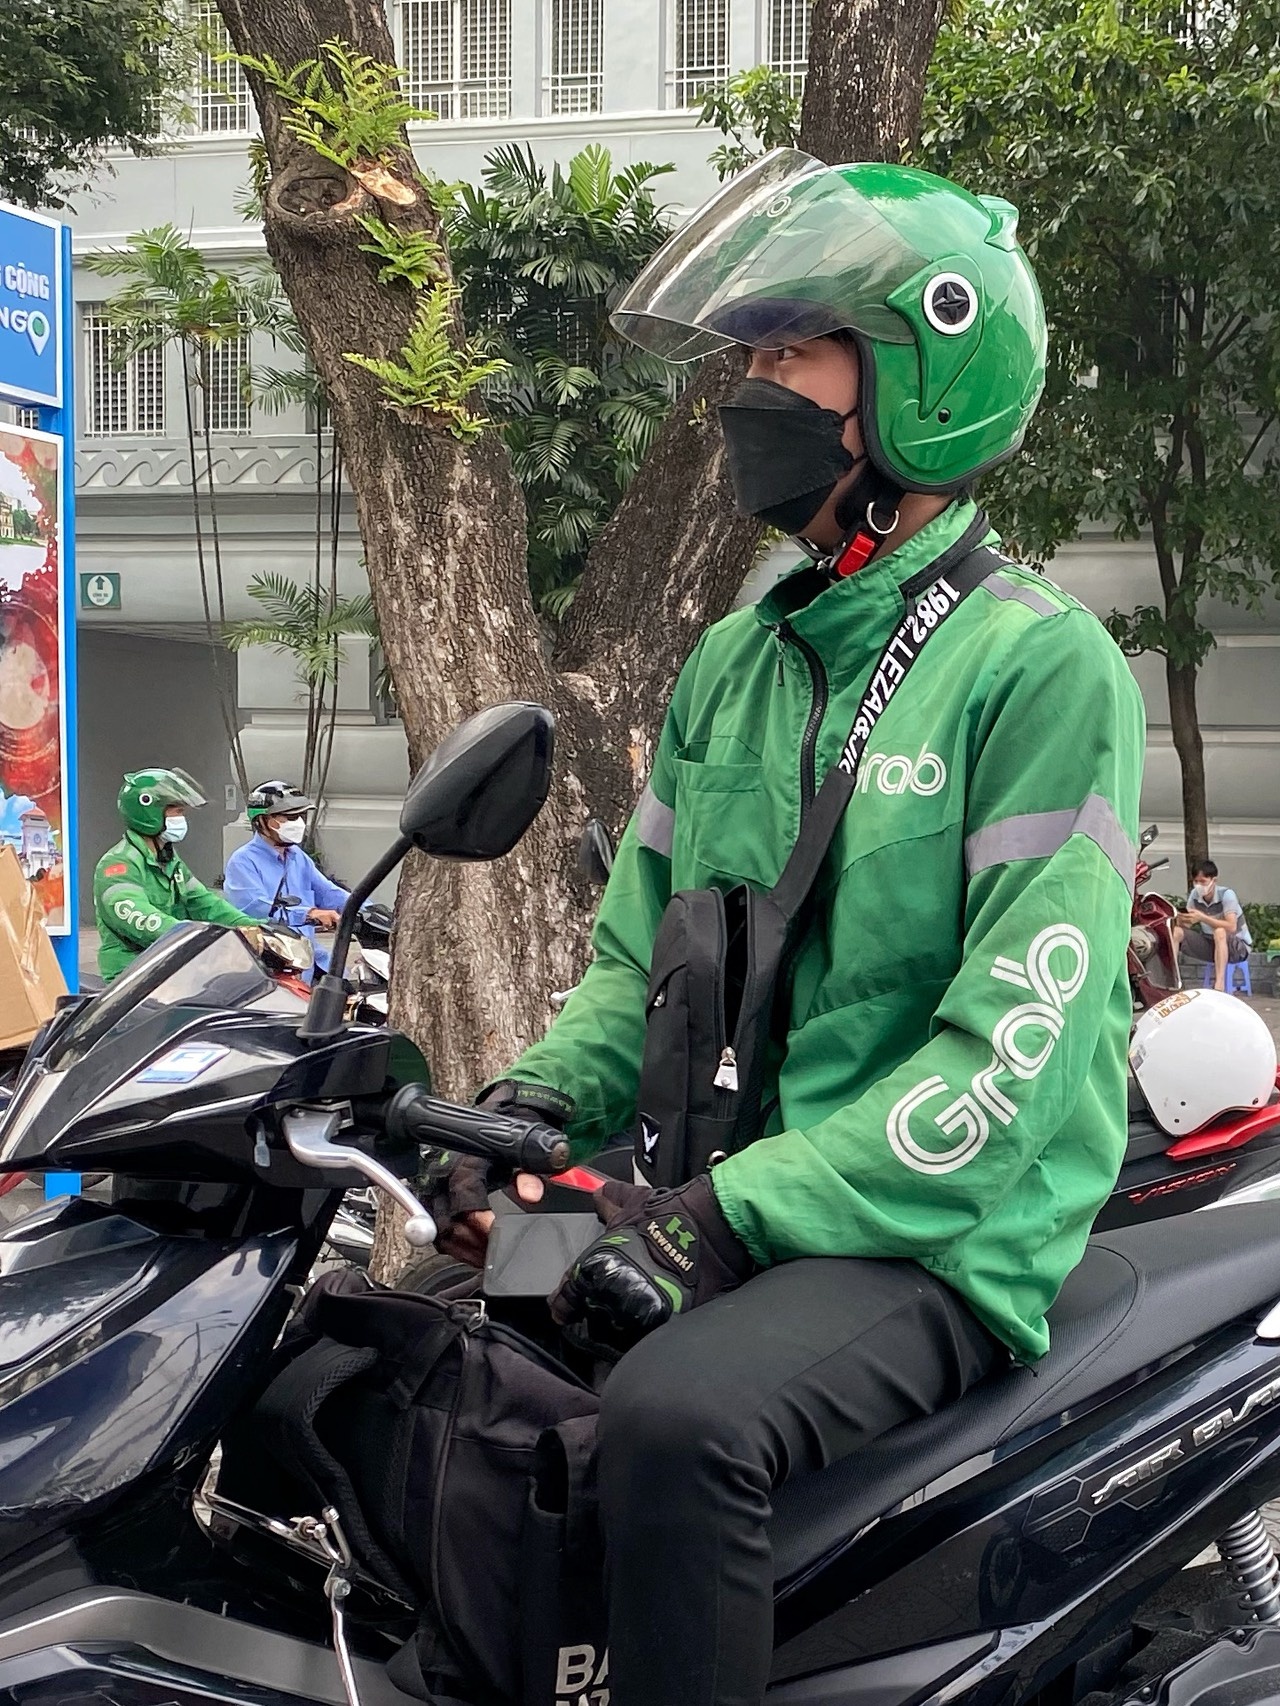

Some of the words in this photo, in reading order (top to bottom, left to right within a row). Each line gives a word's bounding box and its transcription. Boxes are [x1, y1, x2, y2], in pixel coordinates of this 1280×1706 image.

[4, 261, 50, 301] CỘNG
[113, 899, 163, 933] Grab
[885, 922, 1090, 1176] Grab
[646, 1220, 695, 1273] Kawasaki
[1091, 1438, 1186, 1506] AIR
